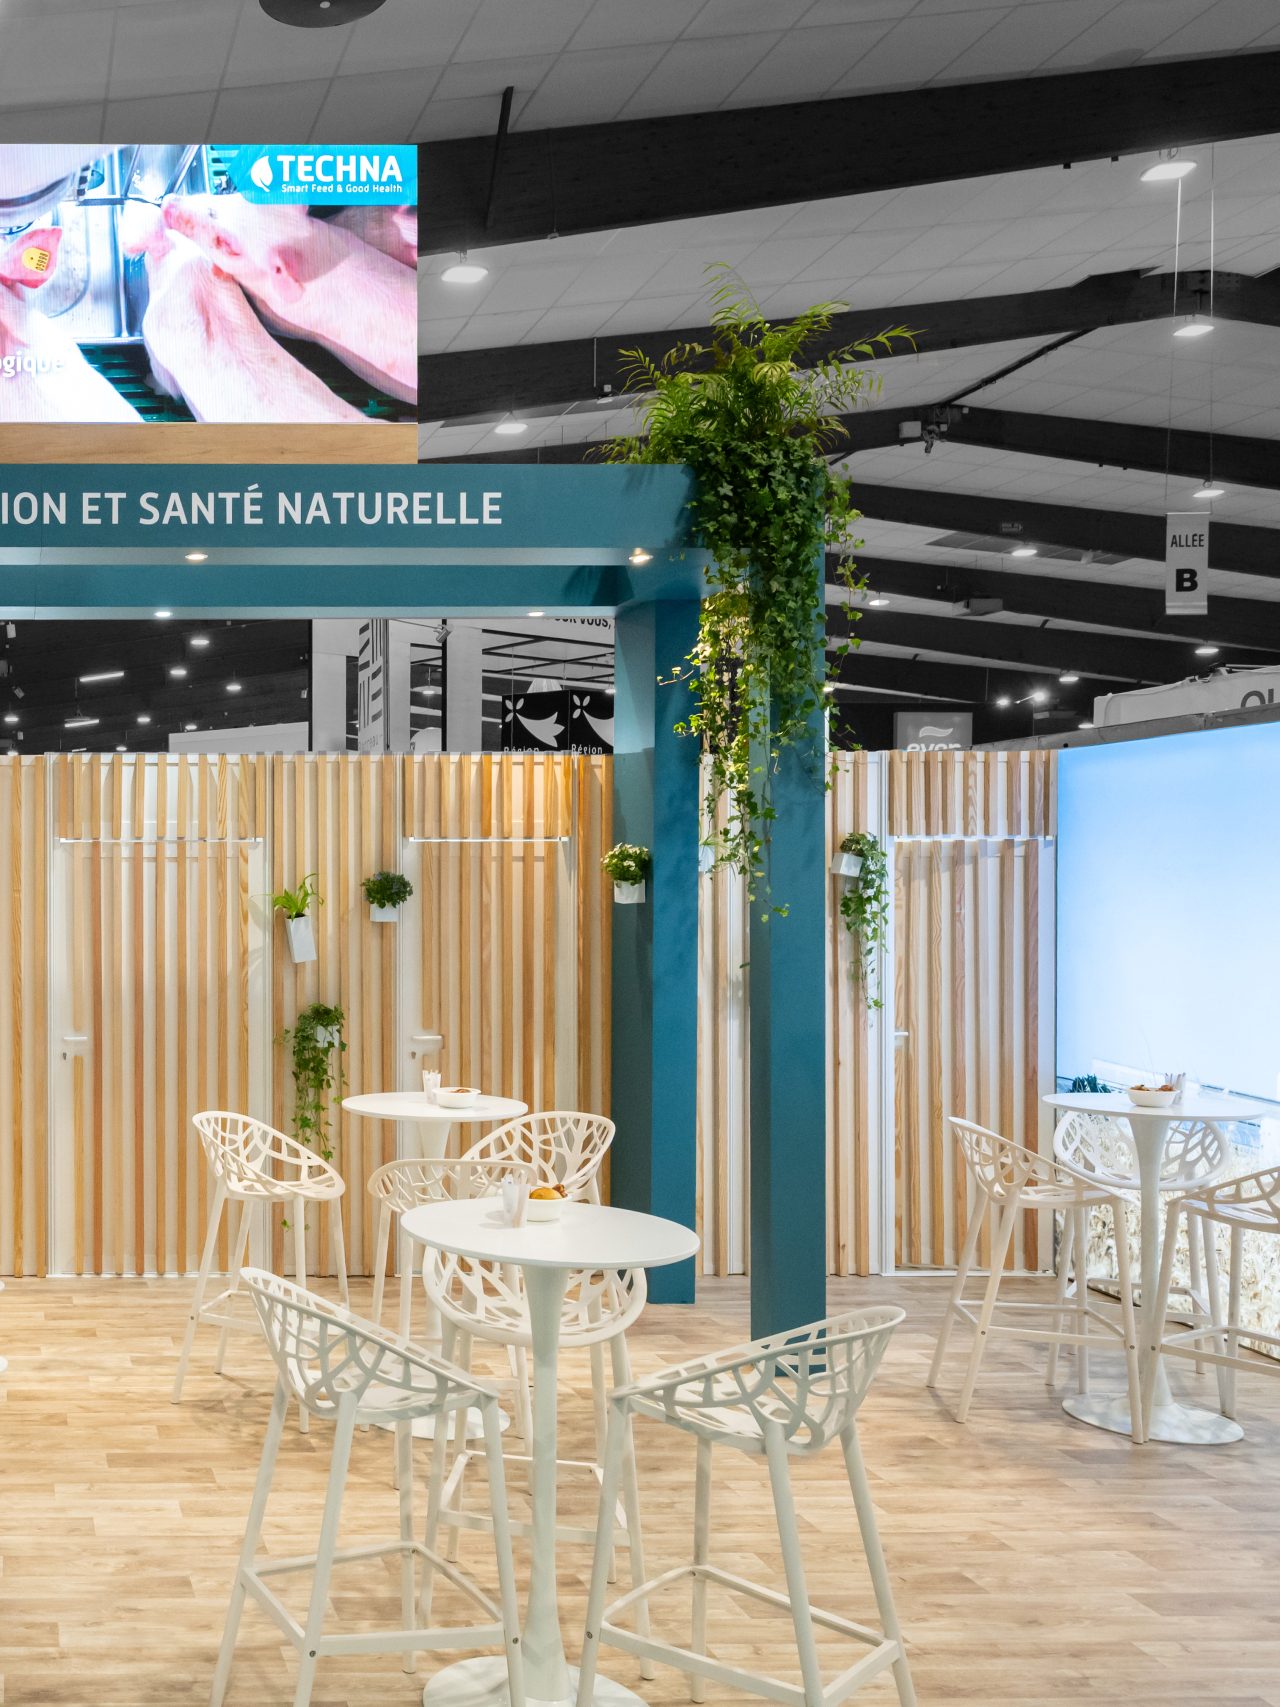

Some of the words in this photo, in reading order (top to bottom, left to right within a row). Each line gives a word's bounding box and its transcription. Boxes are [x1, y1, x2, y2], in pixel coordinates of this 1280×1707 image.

[276, 154, 403, 183] TECHNA
[281, 183, 309, 193] Smart
[311, 183, 334, 193] Feed
[336, 183, 344, 193] &
[345, 183, 370, 193] Good
[372, 183, 403, 193] Health
[82, 491, 126, 525] ET
[139, 483, 264, 525] SANTÉ
[278, 491, 503, 525] NATURELLE
[1170, 532, 1205, 548] ALLÉE
[1175, 568, 1199, 593] B
